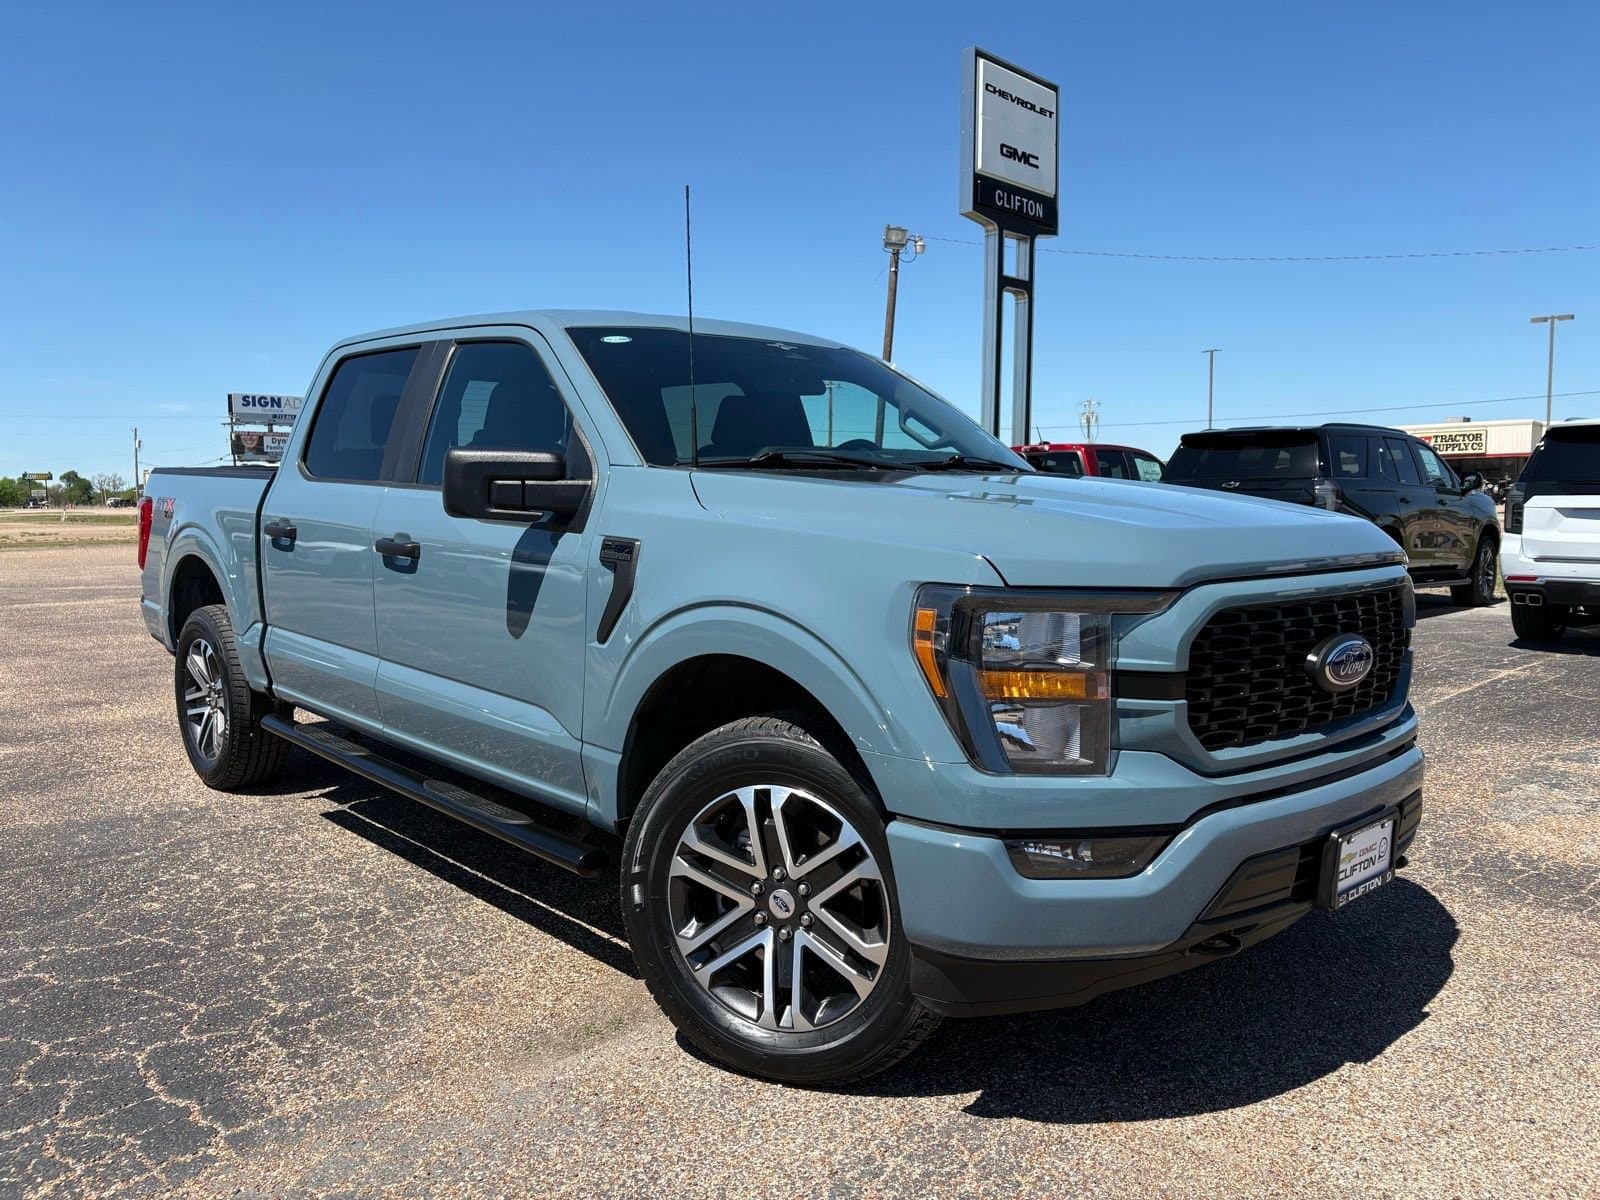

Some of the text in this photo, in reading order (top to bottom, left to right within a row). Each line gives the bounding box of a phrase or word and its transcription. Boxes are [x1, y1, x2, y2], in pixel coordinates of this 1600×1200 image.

[985, 83, 1055, 119] CHEVROLET
[1000, 143, 1039, 169] GMC
[995, 189, 1044, 219] CLIFTON
[1432, 443, 1470, 452] SUPPLY
[1433, 433, 1483, 443] TRACTOR
[1338, 855, 1376, 881] CLIFTON
[1349, 875, 1382, 901] CLIFTON
